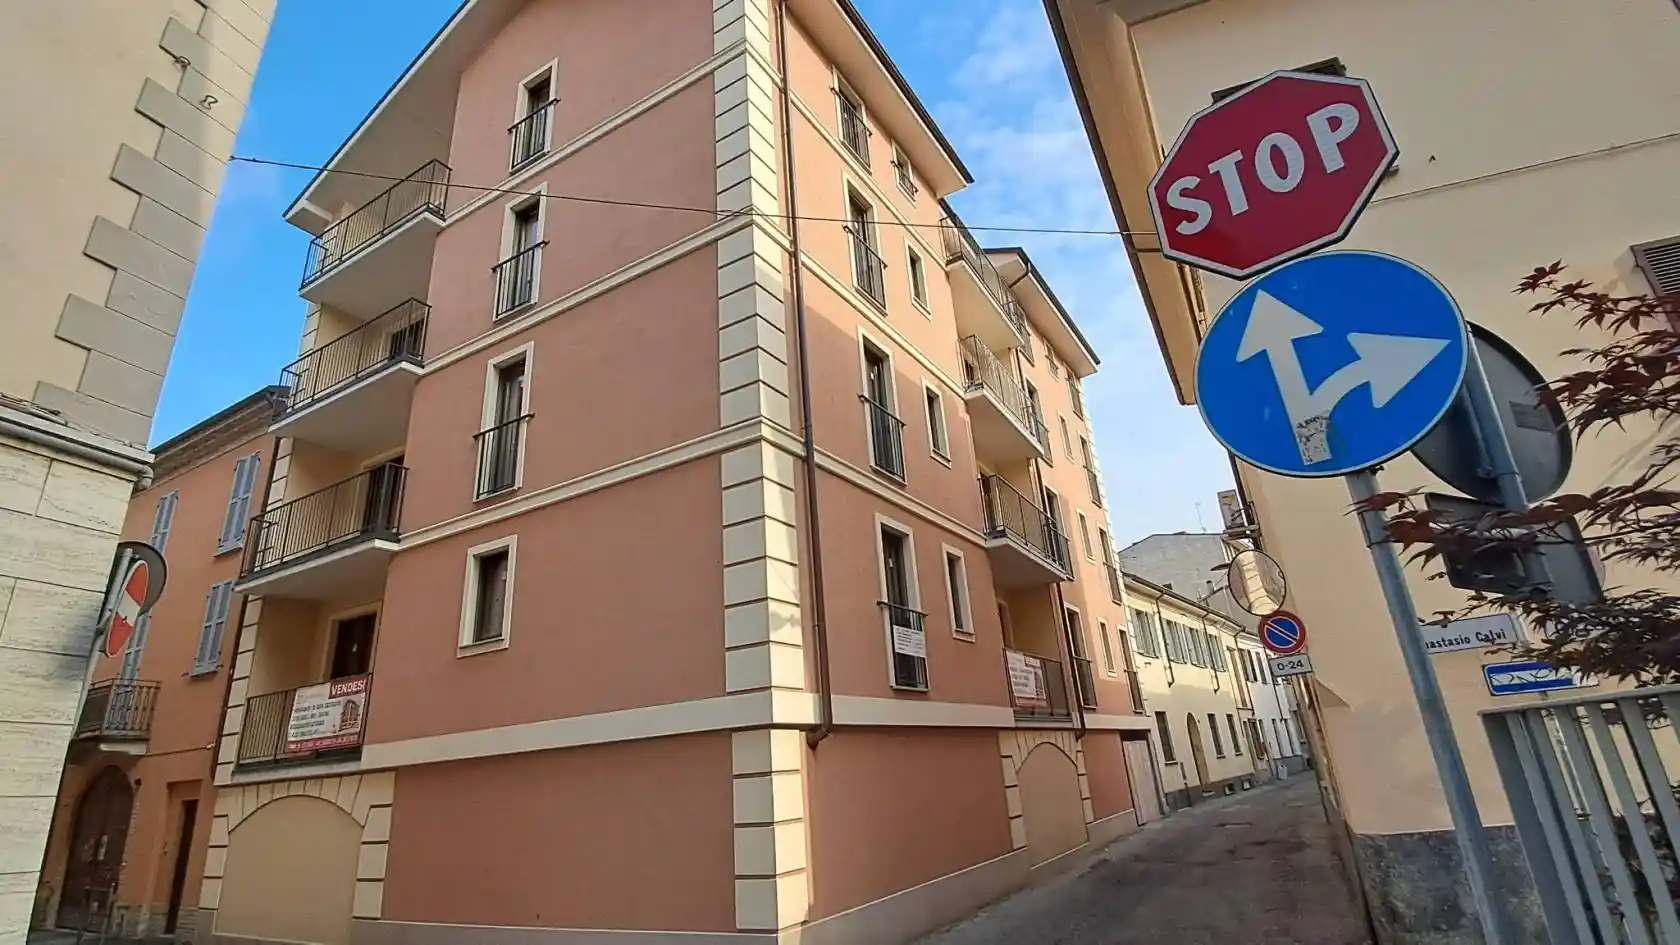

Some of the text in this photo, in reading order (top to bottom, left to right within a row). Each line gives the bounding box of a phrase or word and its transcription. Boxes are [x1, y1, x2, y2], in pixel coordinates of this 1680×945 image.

[1166, 102, 1360, 236] STOP
[1475, 628, 1507, 643] Calvi
[1276, 660, 1304, 671] 0-24
